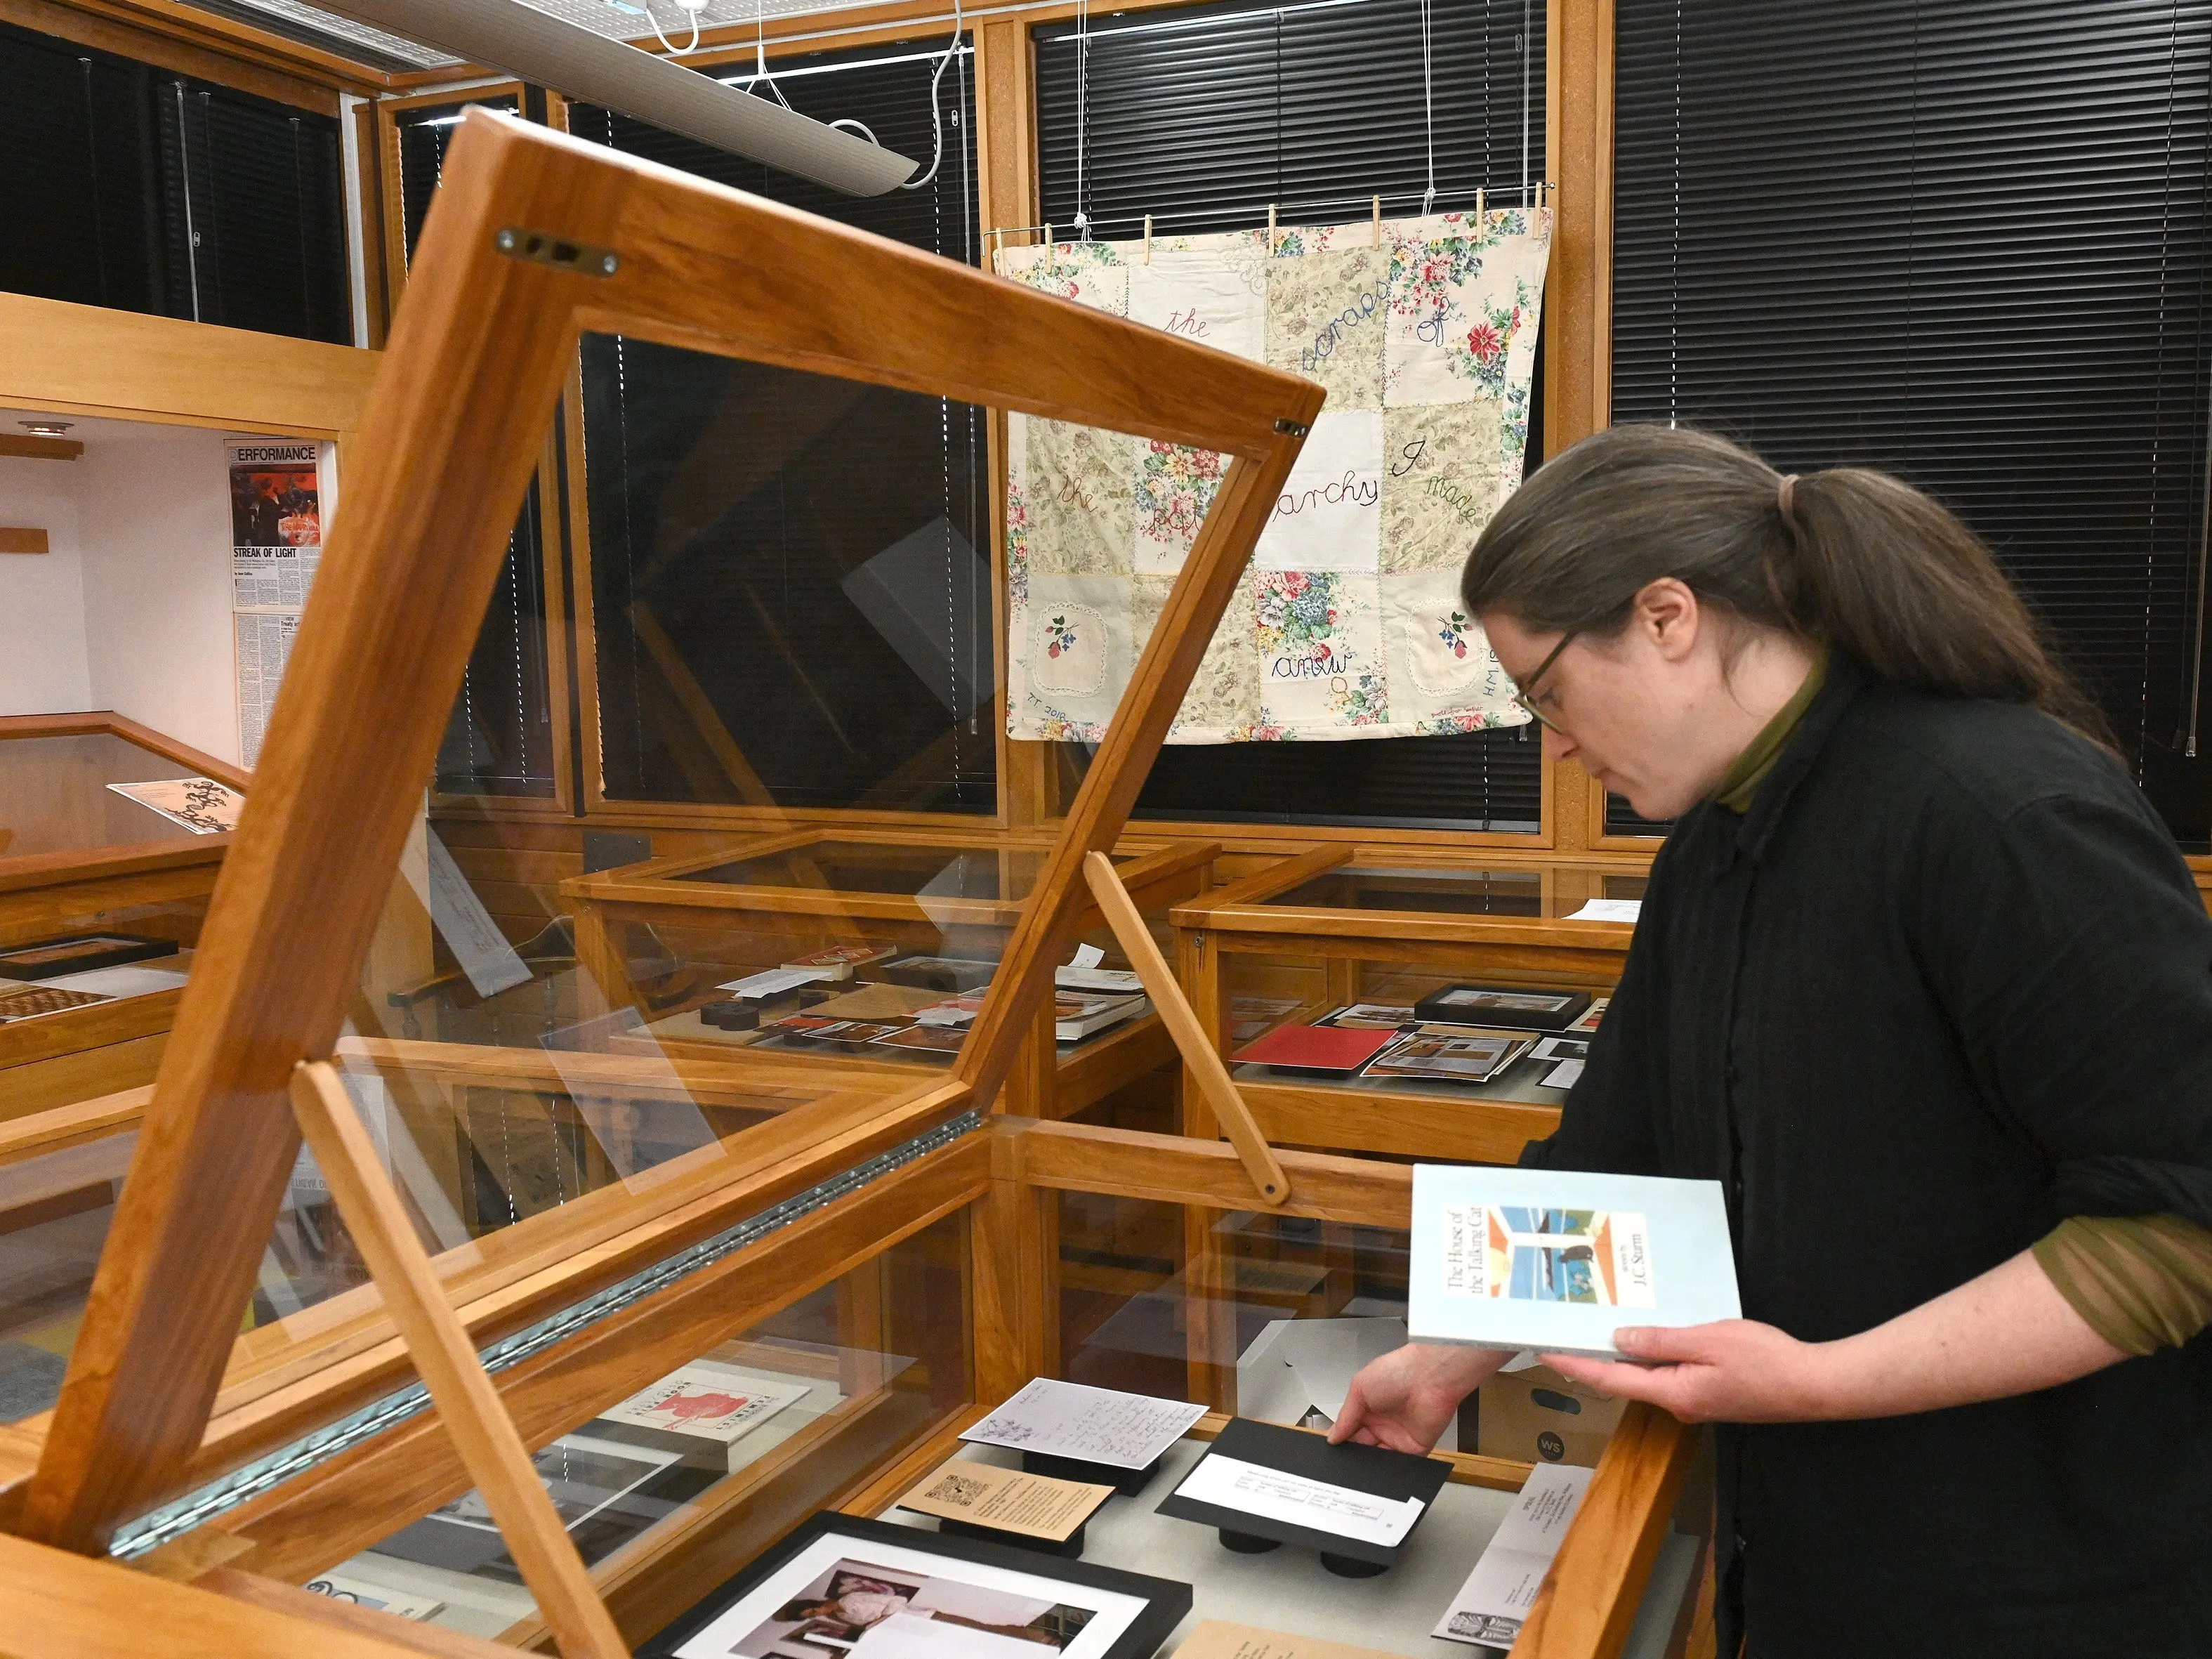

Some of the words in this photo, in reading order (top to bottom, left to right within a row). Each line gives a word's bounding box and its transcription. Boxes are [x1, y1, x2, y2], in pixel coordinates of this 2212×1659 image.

[1163, 308, 1211, 338] the
[1302, 280, 1390, 372] scraps
[1416, 296, 1450, 348] of
[1056, 474, 1098, 513] the
[1272, 470, 1378, 523] archy
[1388, 440, 1426, 477] I
[1425, 476, 1476, 524] made
[234, 548, 261, 558] STREAK
[263, 548, 273, 558] OF
[275, 548, 296, 558] LIGHT
[1272, 655, 1352, 677] anew
[1044, 705, 1066, 722] 2016
[1447, 1209, 1463, 1224] of
[1467, 1207, 1482, 1227] Cat
[1447, 1227, 1463, 1263] House
[1468, 1230, 1486, 1273] Talking
[1631, 1233, 1644, 1264] Sturm
[1447, 1267, 1463, 1290] The
[1468, 1276, 1483, 1294] the
[1541, 1439, 1561, 1453] WS
